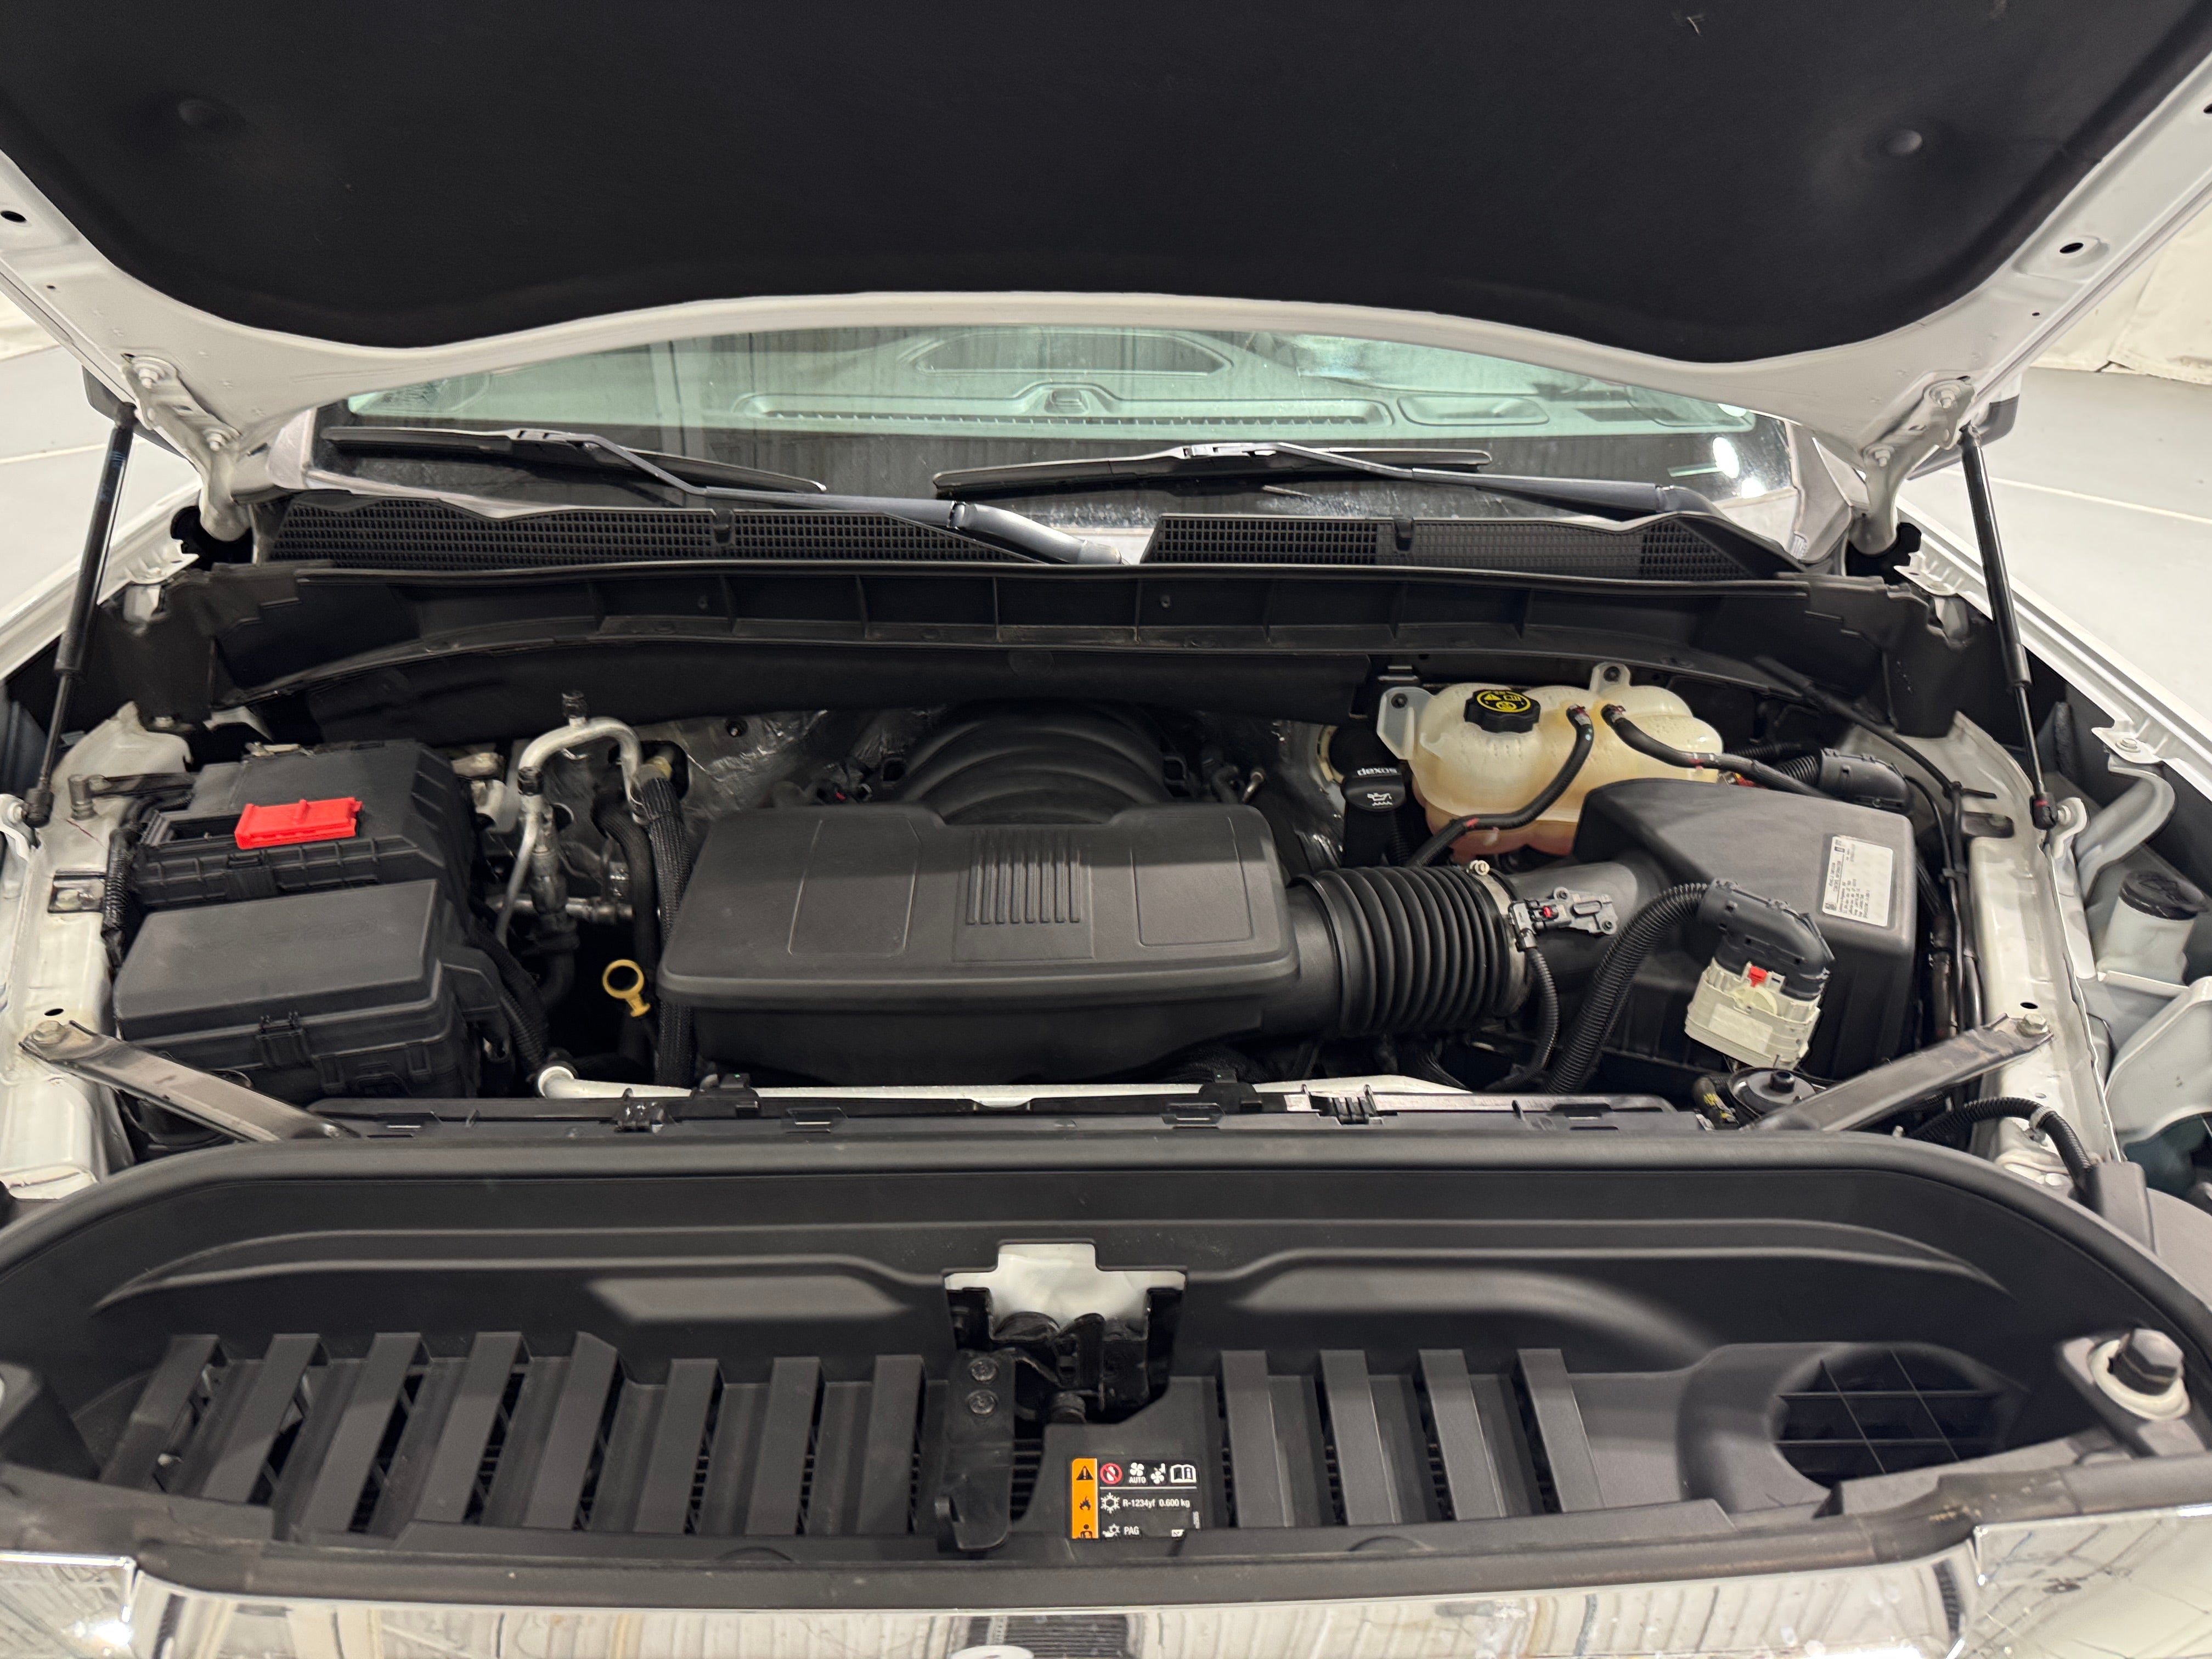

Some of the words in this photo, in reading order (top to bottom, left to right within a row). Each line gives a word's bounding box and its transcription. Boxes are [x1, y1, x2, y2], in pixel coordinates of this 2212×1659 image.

[1357, 768, 1398, 776] dexos
[1123, 1499, 1155, 1508] R-1234yf
[1181, 1498, 1190, 1508] kg
[1124, 1526, 1139, 1535] PAG
